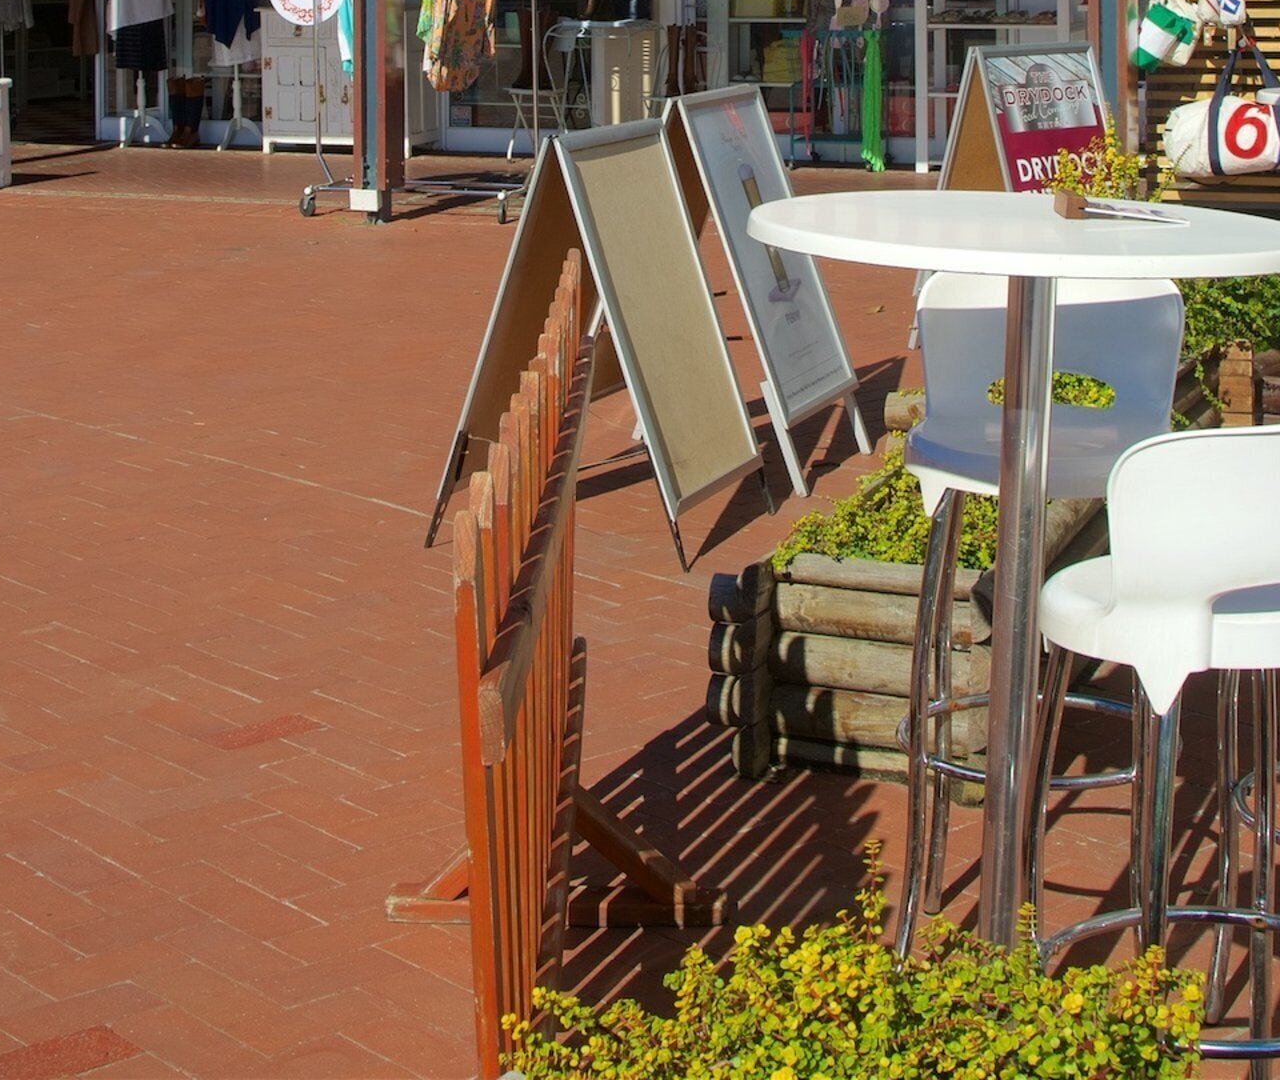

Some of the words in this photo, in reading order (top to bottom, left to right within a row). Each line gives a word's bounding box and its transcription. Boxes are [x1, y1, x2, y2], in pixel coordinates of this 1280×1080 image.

[1030, 71, 1051, 84] THE
[1003, 85, 1088, 107] DRYDOCK
[1225, 102, 1272, 160] 6
